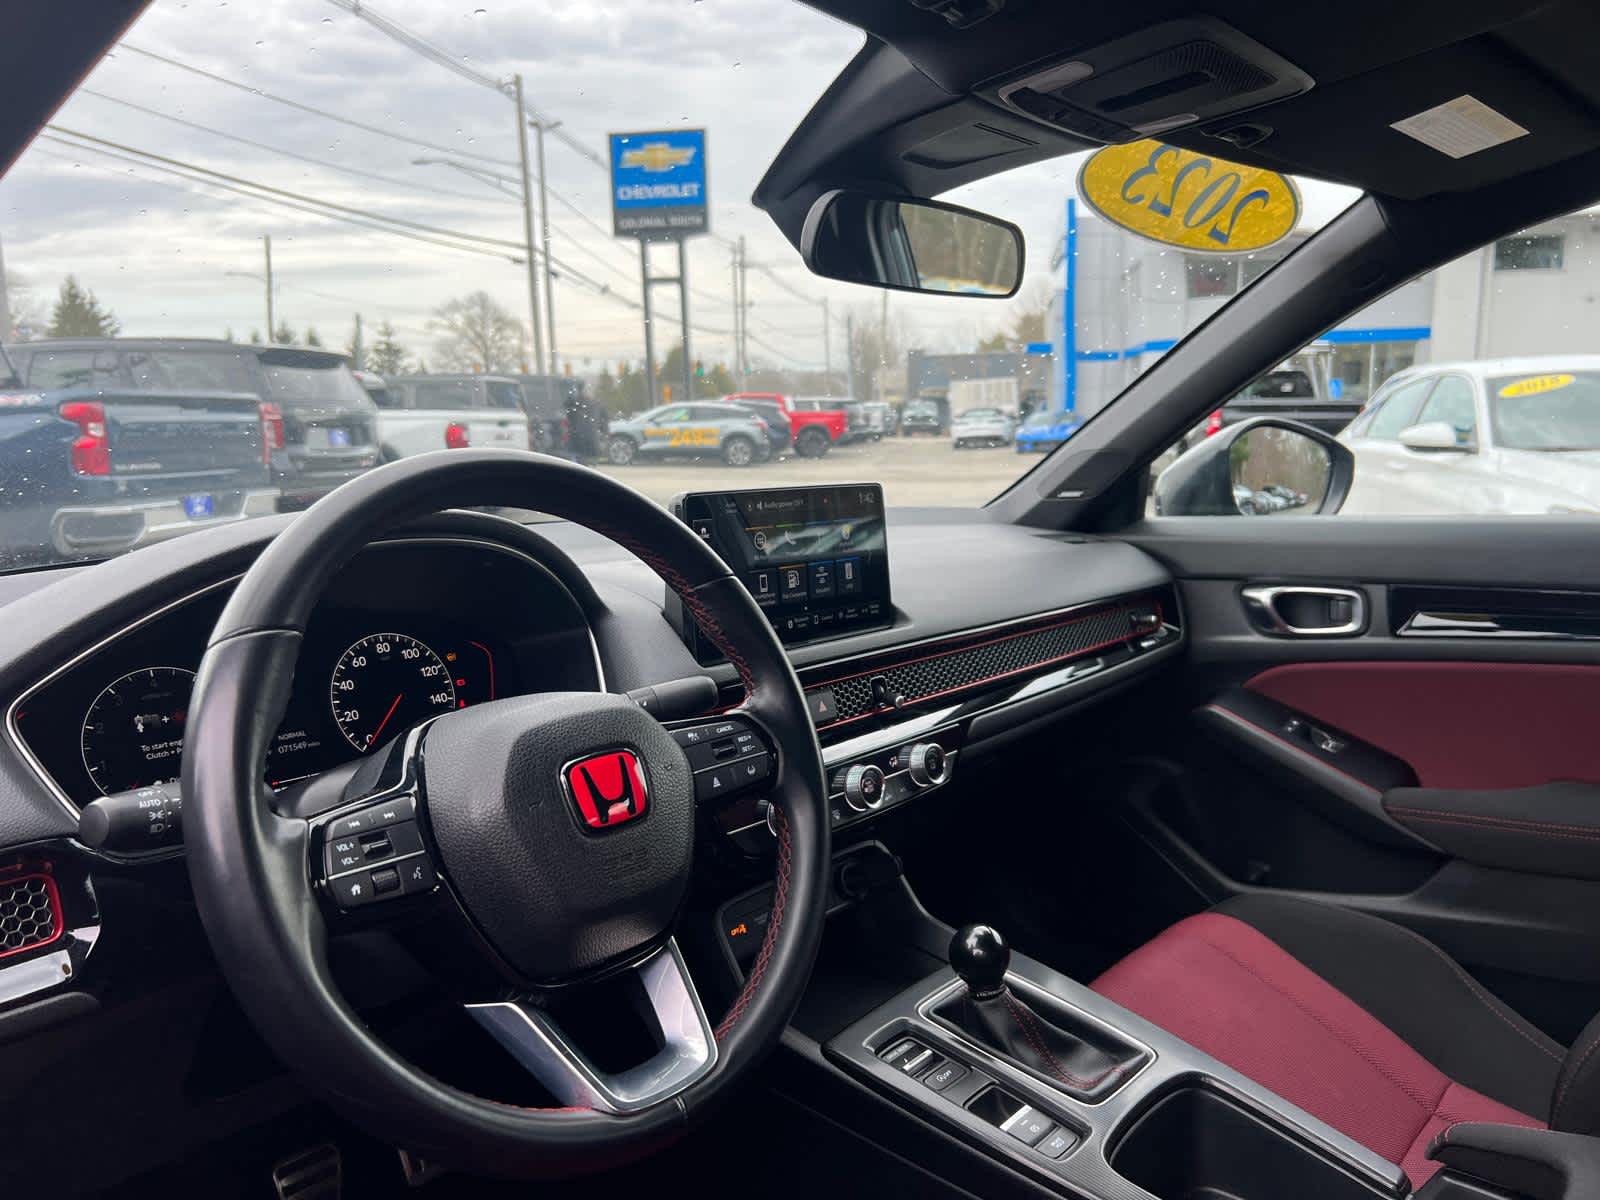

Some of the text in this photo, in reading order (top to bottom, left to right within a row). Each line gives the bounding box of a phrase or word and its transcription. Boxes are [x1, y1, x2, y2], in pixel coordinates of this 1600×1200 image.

[616, 182, 700, 200] CHEVROLET
[376, 642, 391, 653] 80
[401, 648, 420, 660] 100
[352, 656, 367, 667] 60
[420, 665, 439, 677] 120
[339, 679, 354, 691] 40
[430, 693, 448, 704] 140
[344, 710, 359, 721] 20
[716, 725, 734, 734] CANCEL
[278, 730, 306, 741] NORMAL
[140, 744, 151, 752] To
[151, 742, 168, 750] start
[146, 750, 169, 760] Clutch
[139, 798, 161, 809] AUTO
